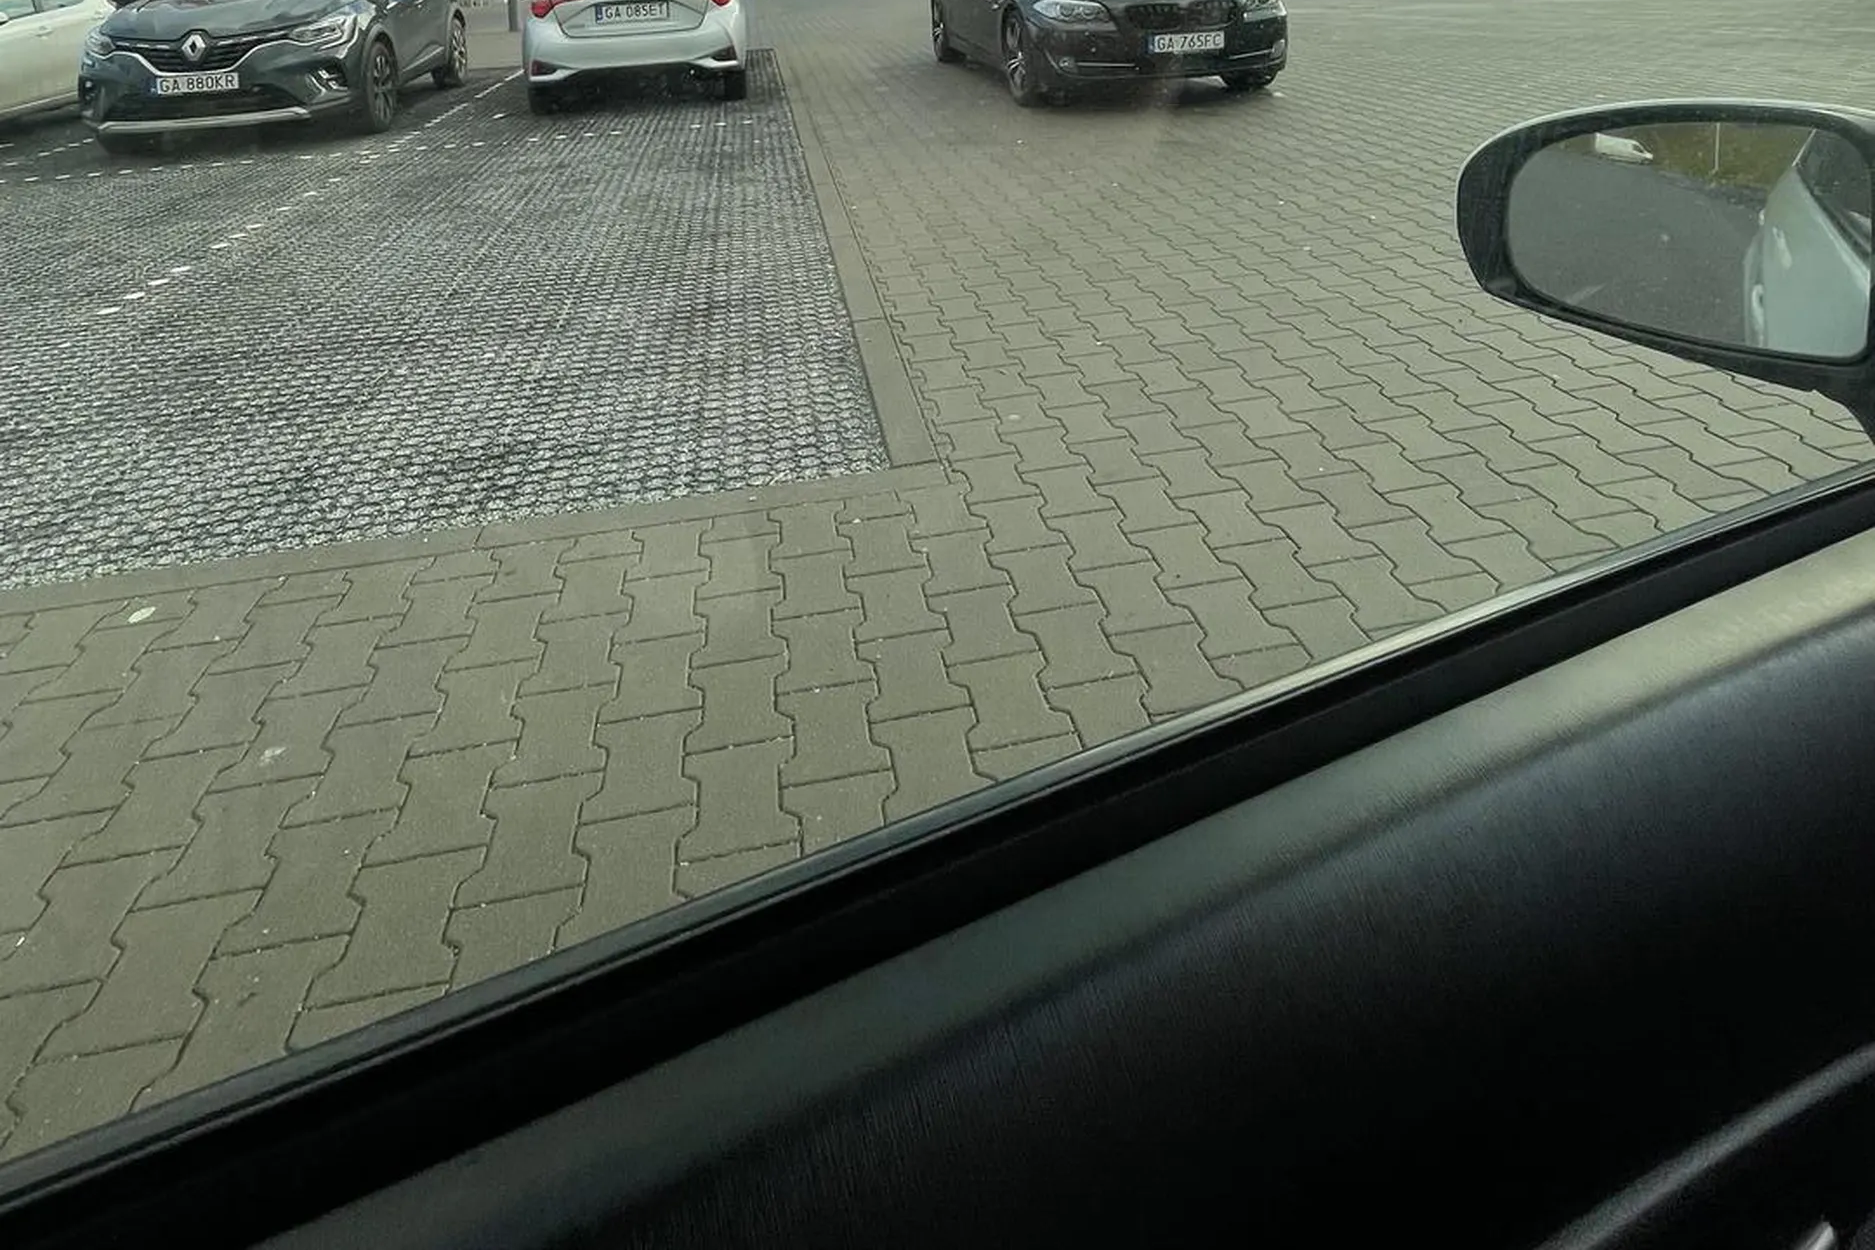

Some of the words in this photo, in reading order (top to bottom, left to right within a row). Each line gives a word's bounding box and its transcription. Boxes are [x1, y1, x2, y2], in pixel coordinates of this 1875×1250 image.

[605, 6, 621, 19] GA
[1157, 37, 1174, 51] GA
[160, 79, 181, 92] GA
[186, 74, 235, 90] 880KR
